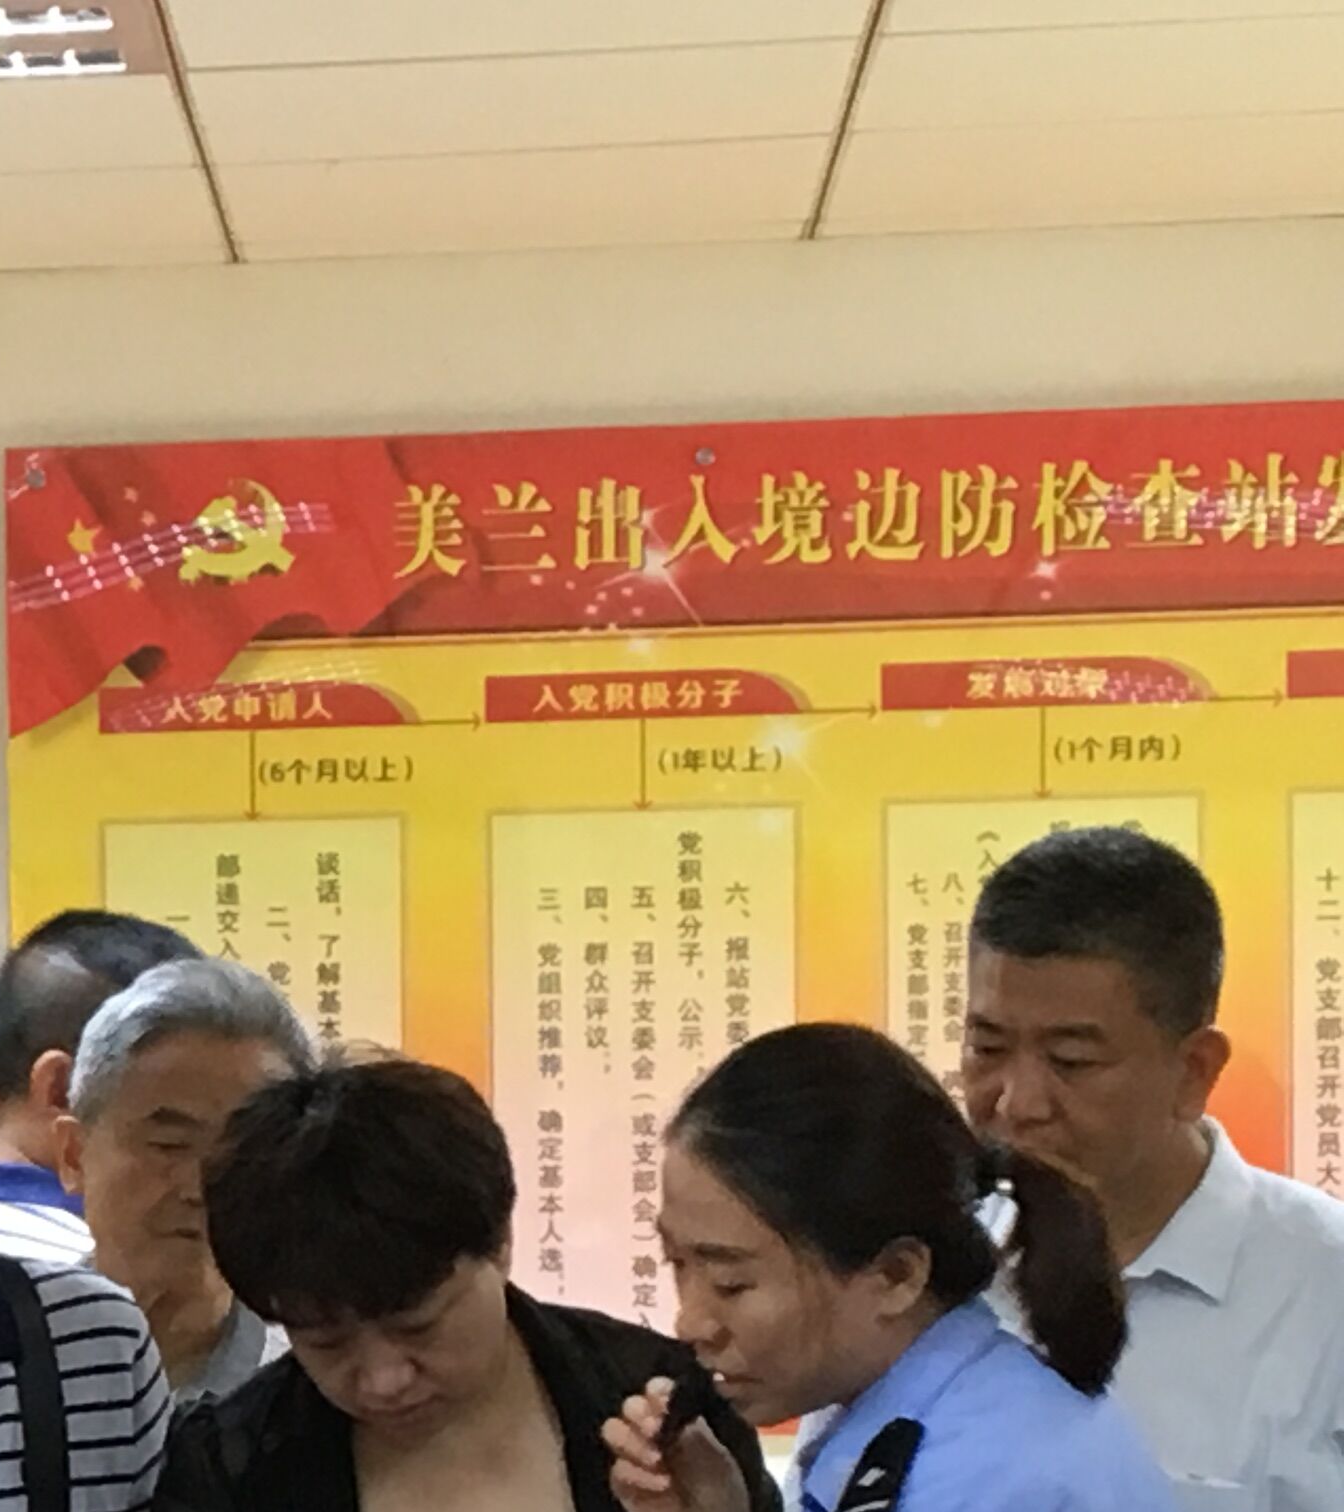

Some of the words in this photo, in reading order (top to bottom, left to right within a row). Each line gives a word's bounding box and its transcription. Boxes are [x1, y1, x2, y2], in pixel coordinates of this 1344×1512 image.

[160, 689, 333, 724] 入党申请人
[531, 677, 744, 715] 入党积极分子
[657, 747, 783, 776] （1年以上）
[1051, 733, 1183, 764] （1个月内）
[257, 753, 415, 787] （6个月以上）
